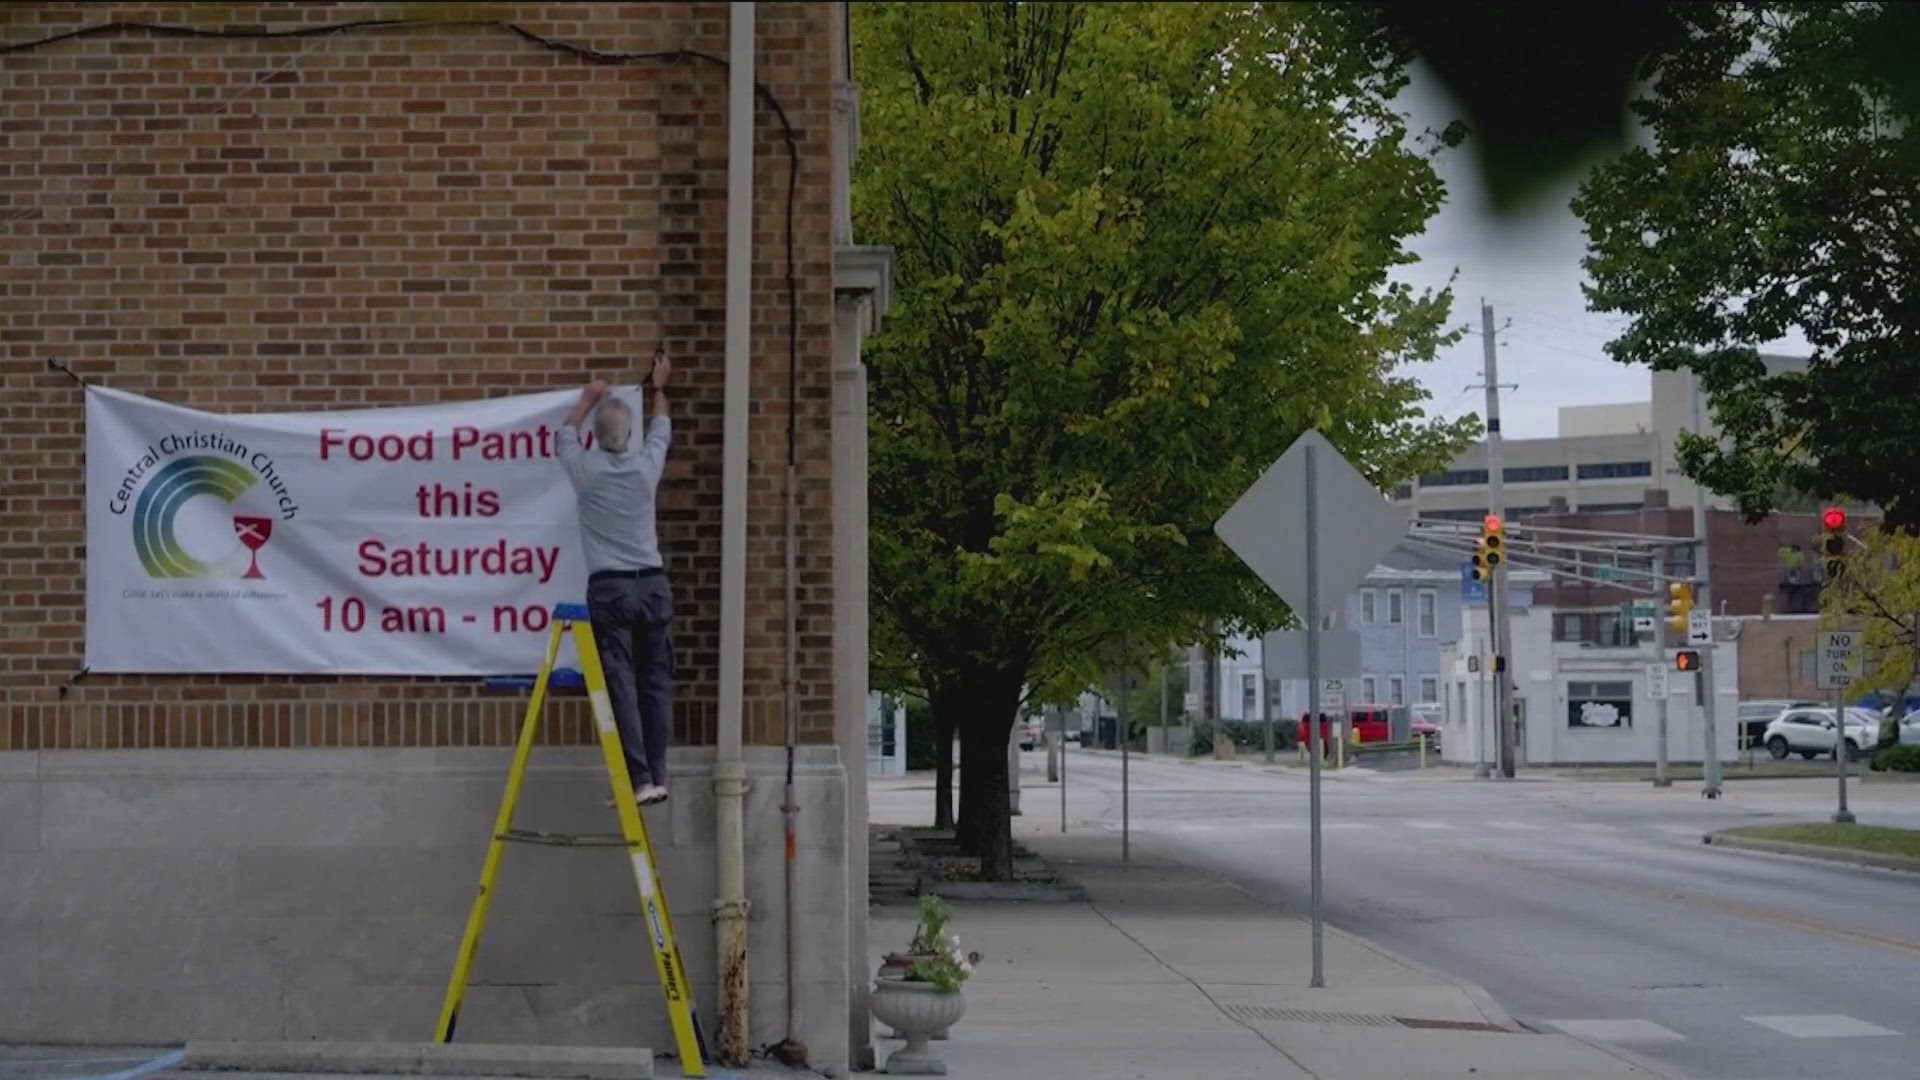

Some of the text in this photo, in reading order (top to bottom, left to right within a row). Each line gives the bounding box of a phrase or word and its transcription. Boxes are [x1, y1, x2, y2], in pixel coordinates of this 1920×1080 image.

[319, 428, 434, 461] Food
[110, 430, 300, 520] Central Christian Church
[416, 482, 501, 518] this
[358, 539, 561, 584] Saturday
[316, 596, 366, 633] 10
[381, 606, 446, 633] am
[462, 614, 477, 624] -
[1830, 634, 1851, 647] NO
[1326, 679, 1343, 690] 25
